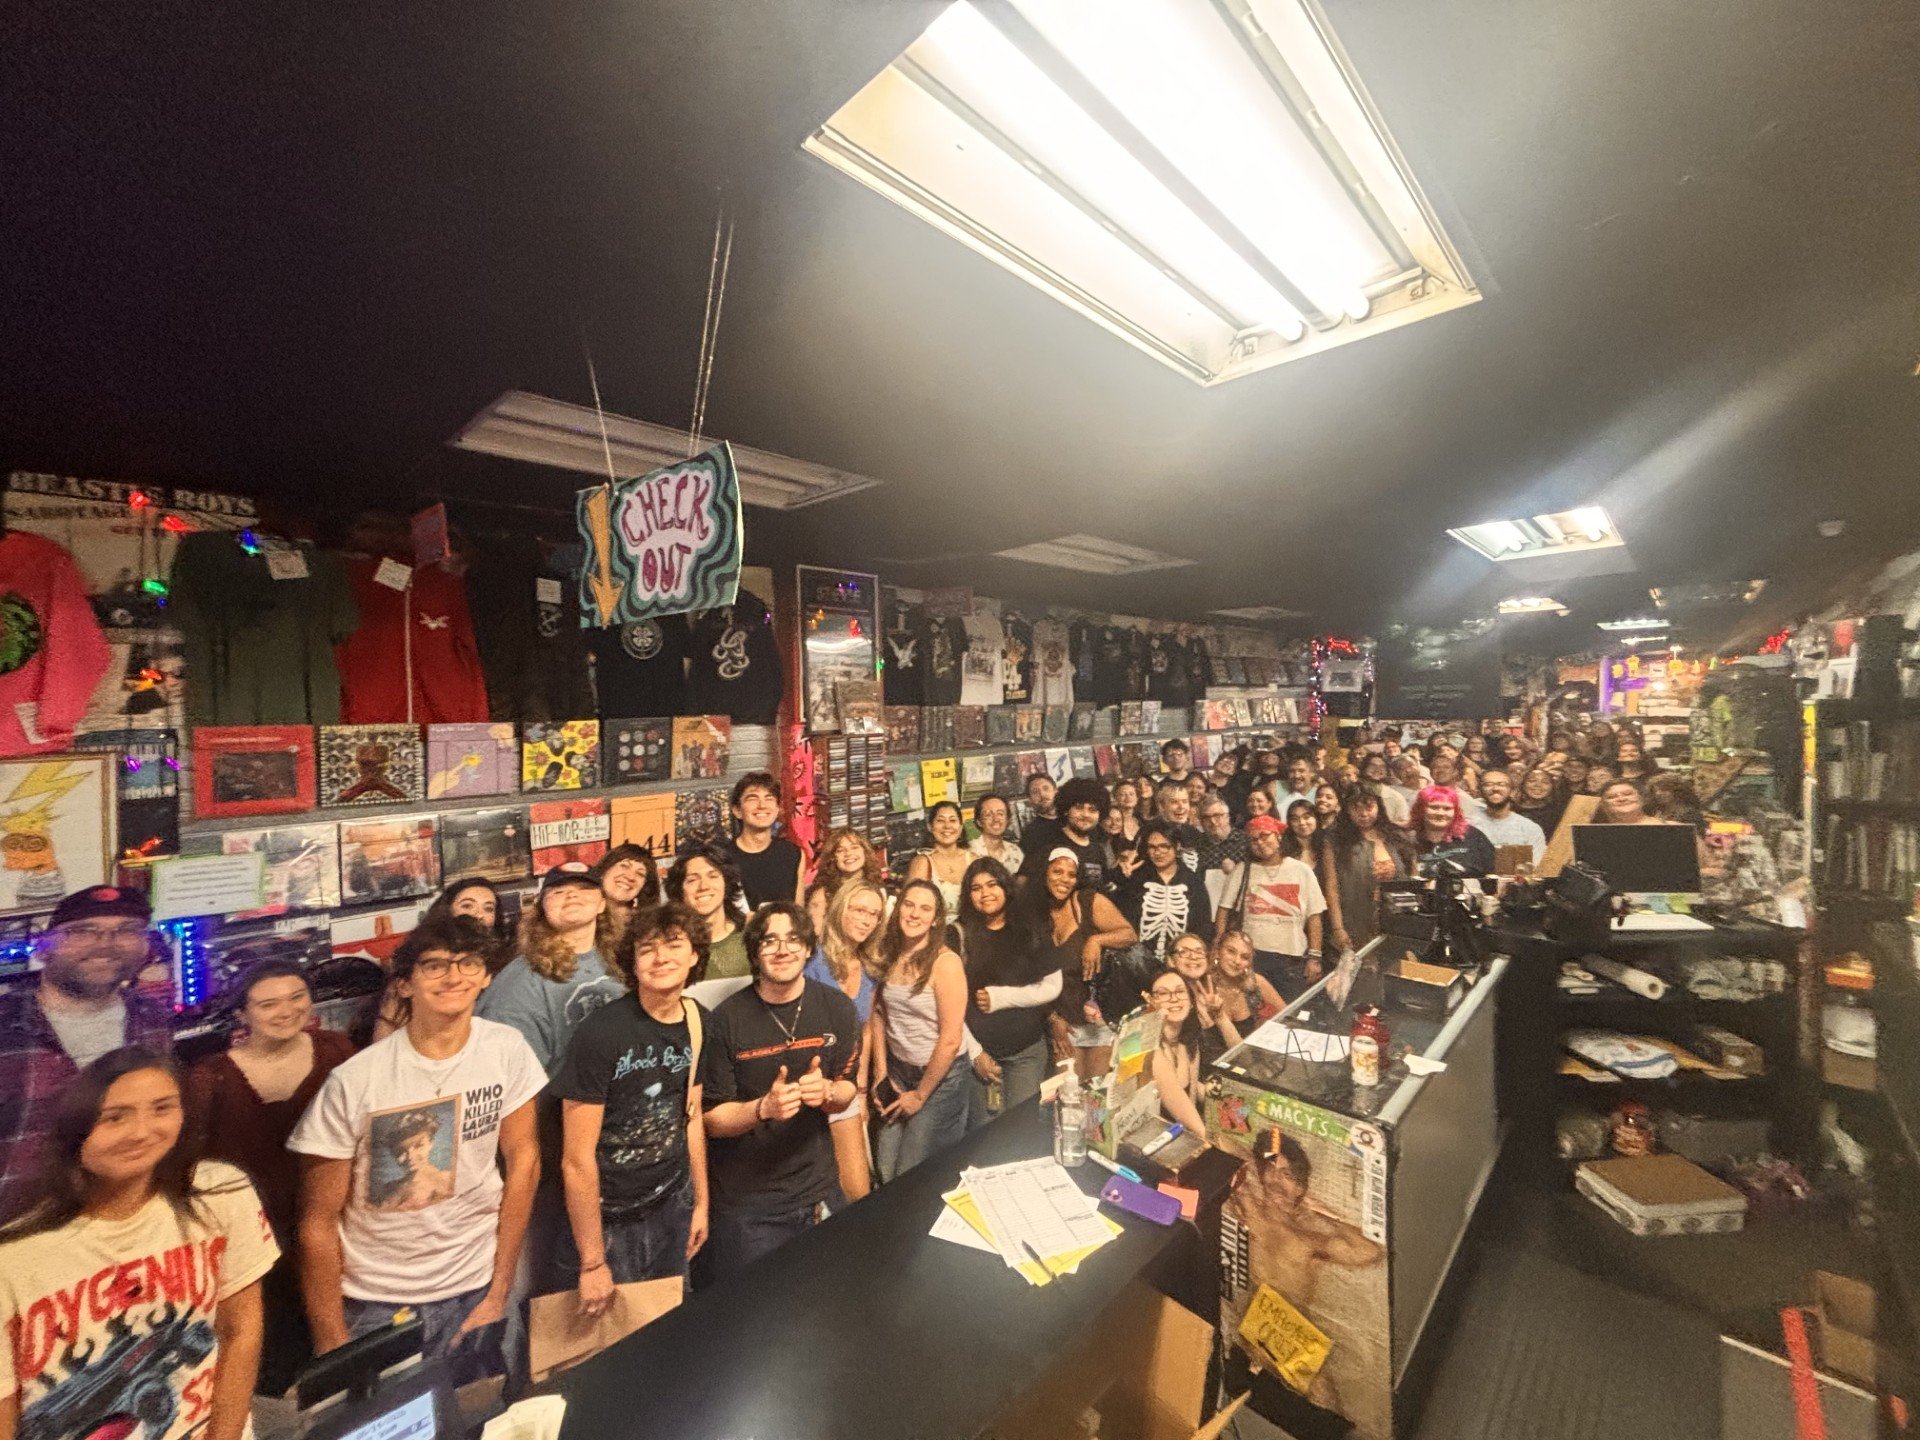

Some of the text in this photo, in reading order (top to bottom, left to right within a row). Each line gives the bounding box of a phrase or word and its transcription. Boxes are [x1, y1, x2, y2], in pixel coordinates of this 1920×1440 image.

[621, 473, 710, 548] CHECK
[642, 542, 692, 593] OUT
[465, 1083, 503, 1106] WHO
[464, 1099, 503, 1121] KILLED
[462, 1112, 499, 1133] LAURA
